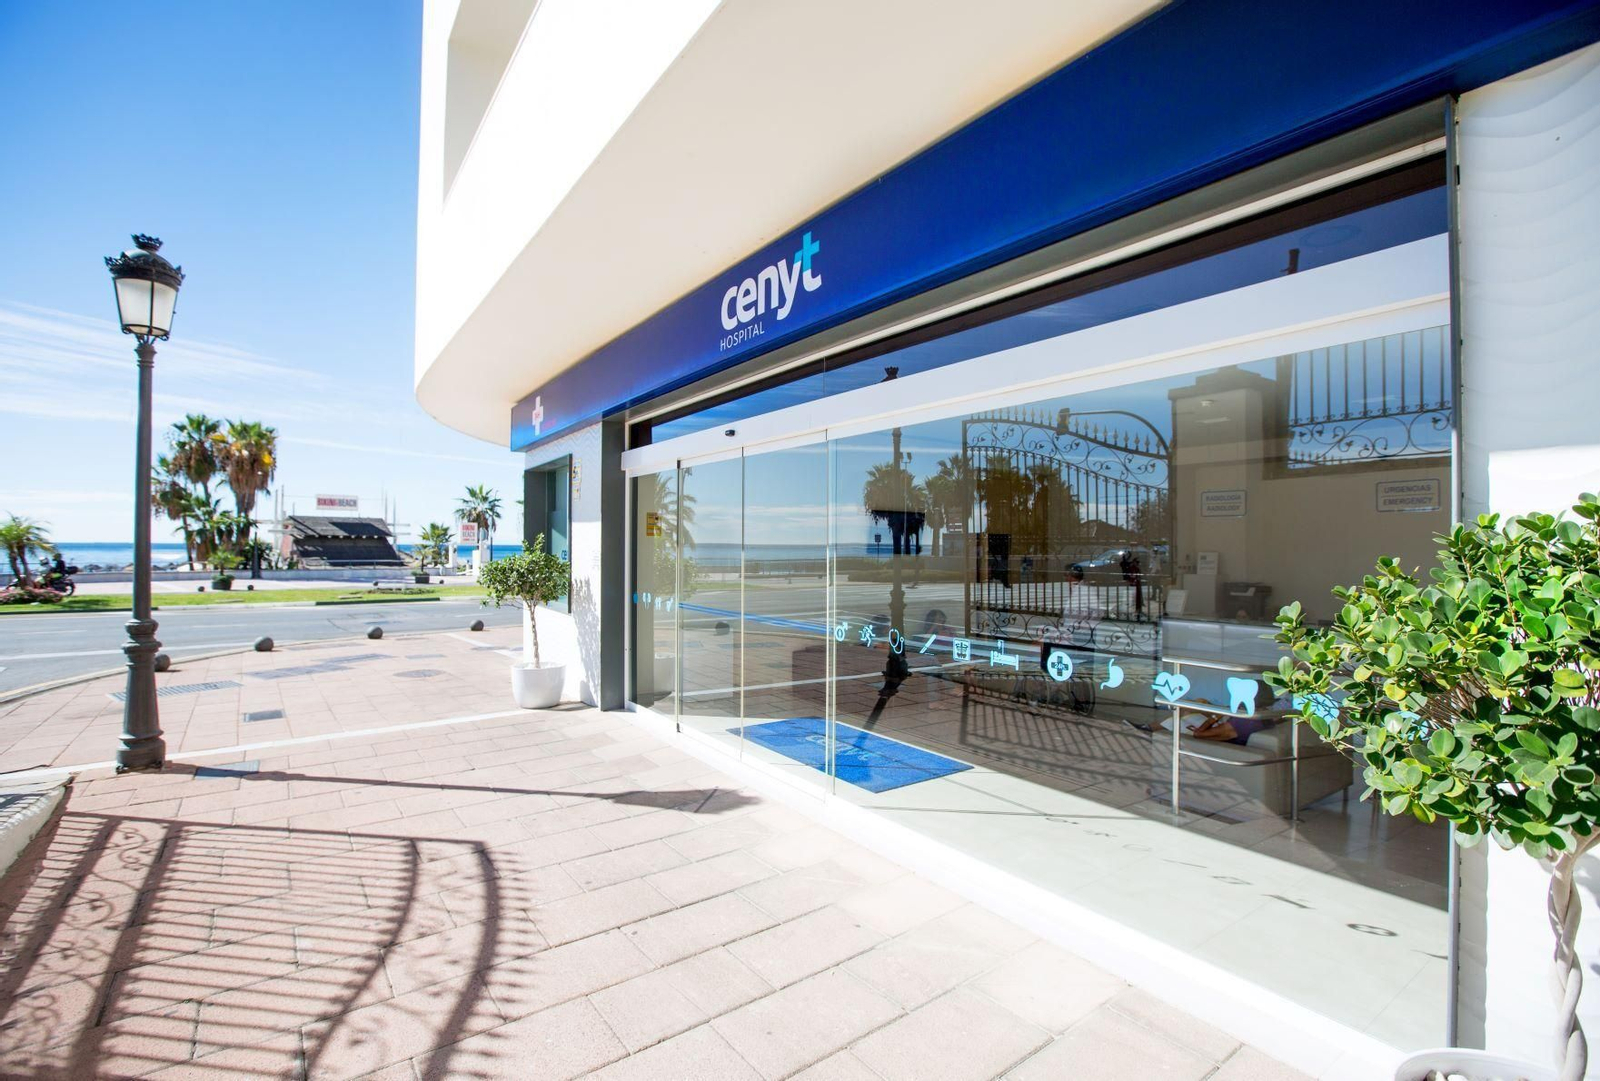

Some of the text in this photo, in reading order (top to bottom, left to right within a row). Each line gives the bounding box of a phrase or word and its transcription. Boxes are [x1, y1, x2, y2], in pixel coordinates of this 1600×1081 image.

[720, 231, 822, 331] cenyt
[719, 321, 765, 352] HOSPITAL
[1384, 484, 1433, 494] URGENCIAS
[1383, 496, 1434, 506] EMERGENCY
